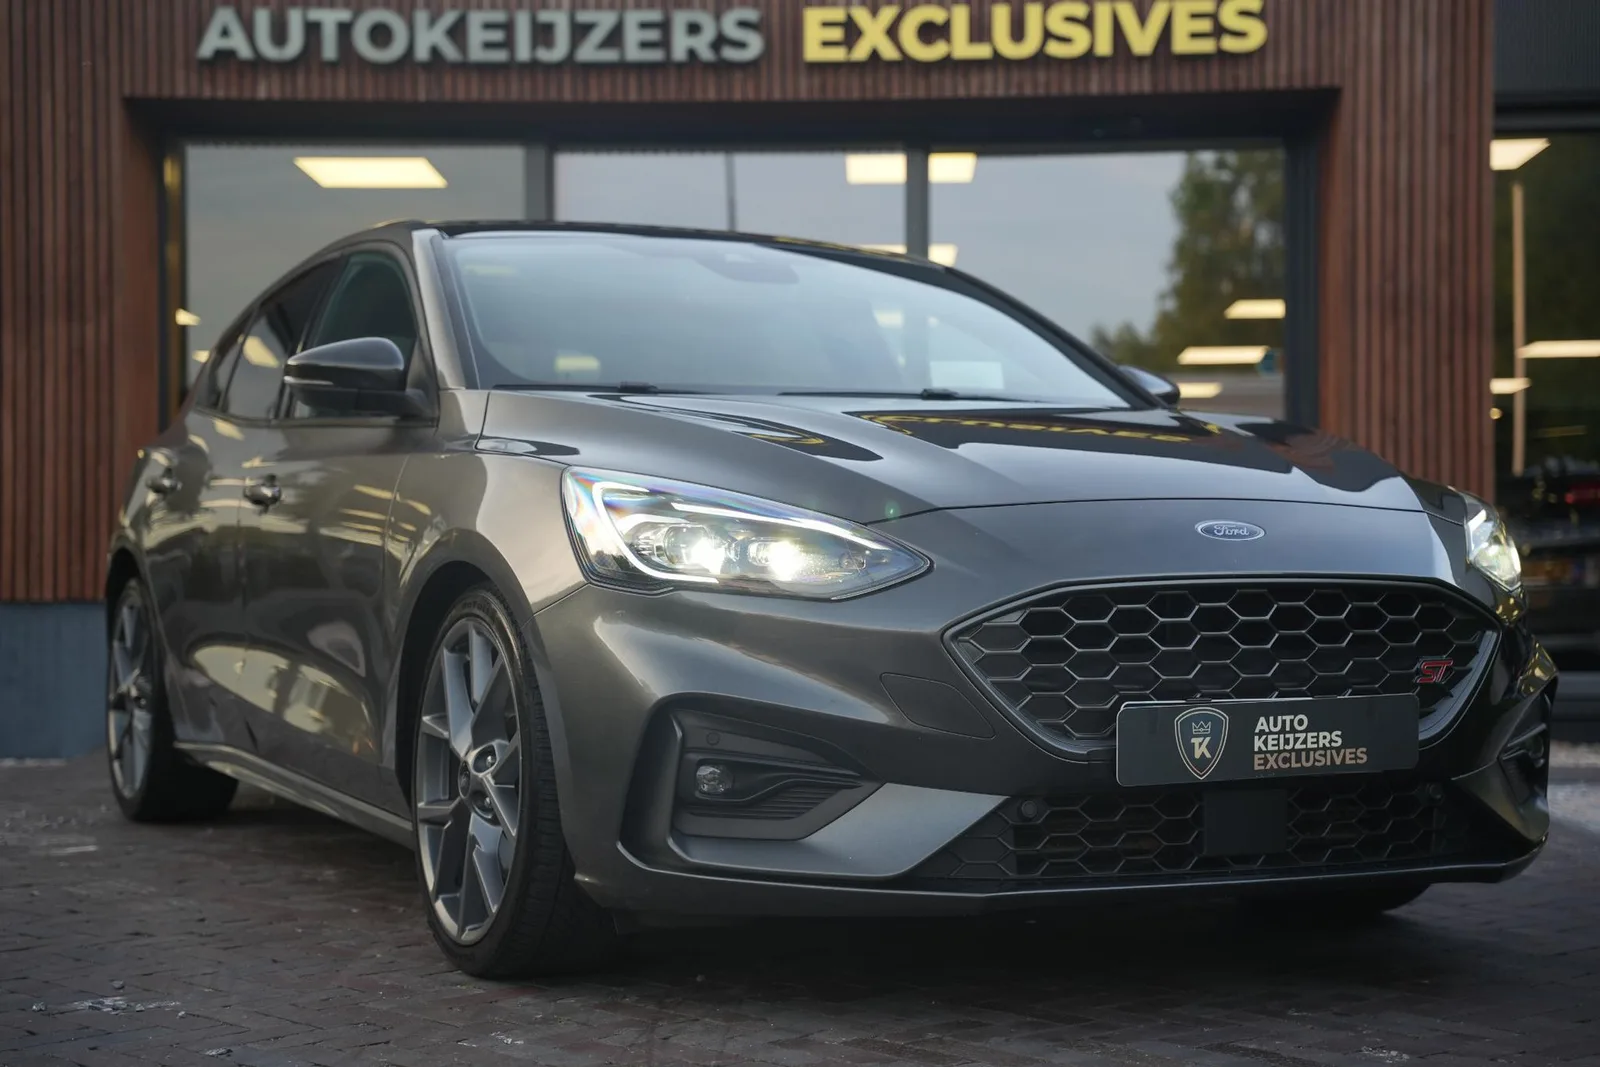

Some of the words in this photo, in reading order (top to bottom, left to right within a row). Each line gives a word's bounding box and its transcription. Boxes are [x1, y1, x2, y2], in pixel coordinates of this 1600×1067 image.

[197, 6, 766, 64] AUTOKEIJZERS
[803, 0, 1268, 63] EXCLUSIVES
[1213, 524, 1250, 536] Ford
[1417, 659, 1454, 683] ST
[1254, 714, 1309, 733] AUTO
[1190, 736, 1212, 759] TK
[1254, 730, 1343, 752] KEIJZERS
[1253, 747, 1368, 771] EXCLUSIVES
